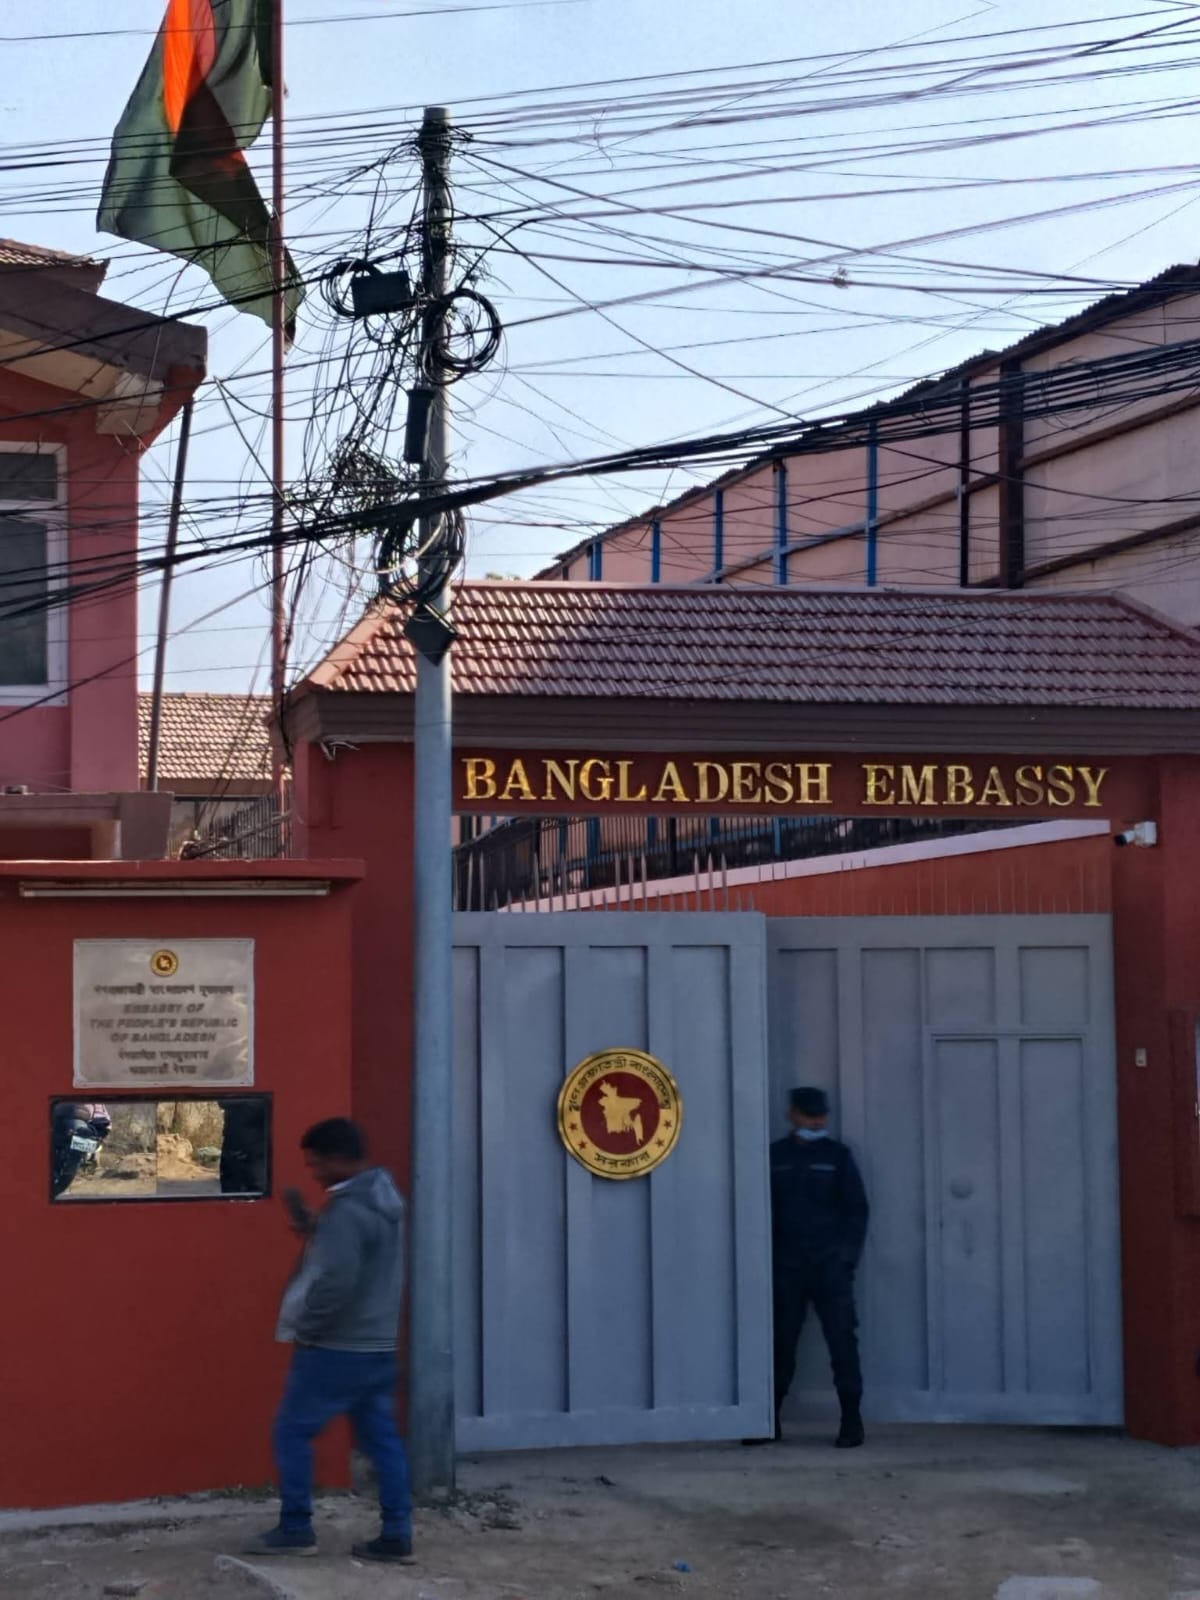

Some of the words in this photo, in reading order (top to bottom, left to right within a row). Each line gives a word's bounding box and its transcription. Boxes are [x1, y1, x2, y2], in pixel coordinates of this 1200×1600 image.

[462, 757, 832, 804] BANGLADESH
[861, 762, 1110, 807] EMBASSY
[186, 1002, 205, 1014] OF
